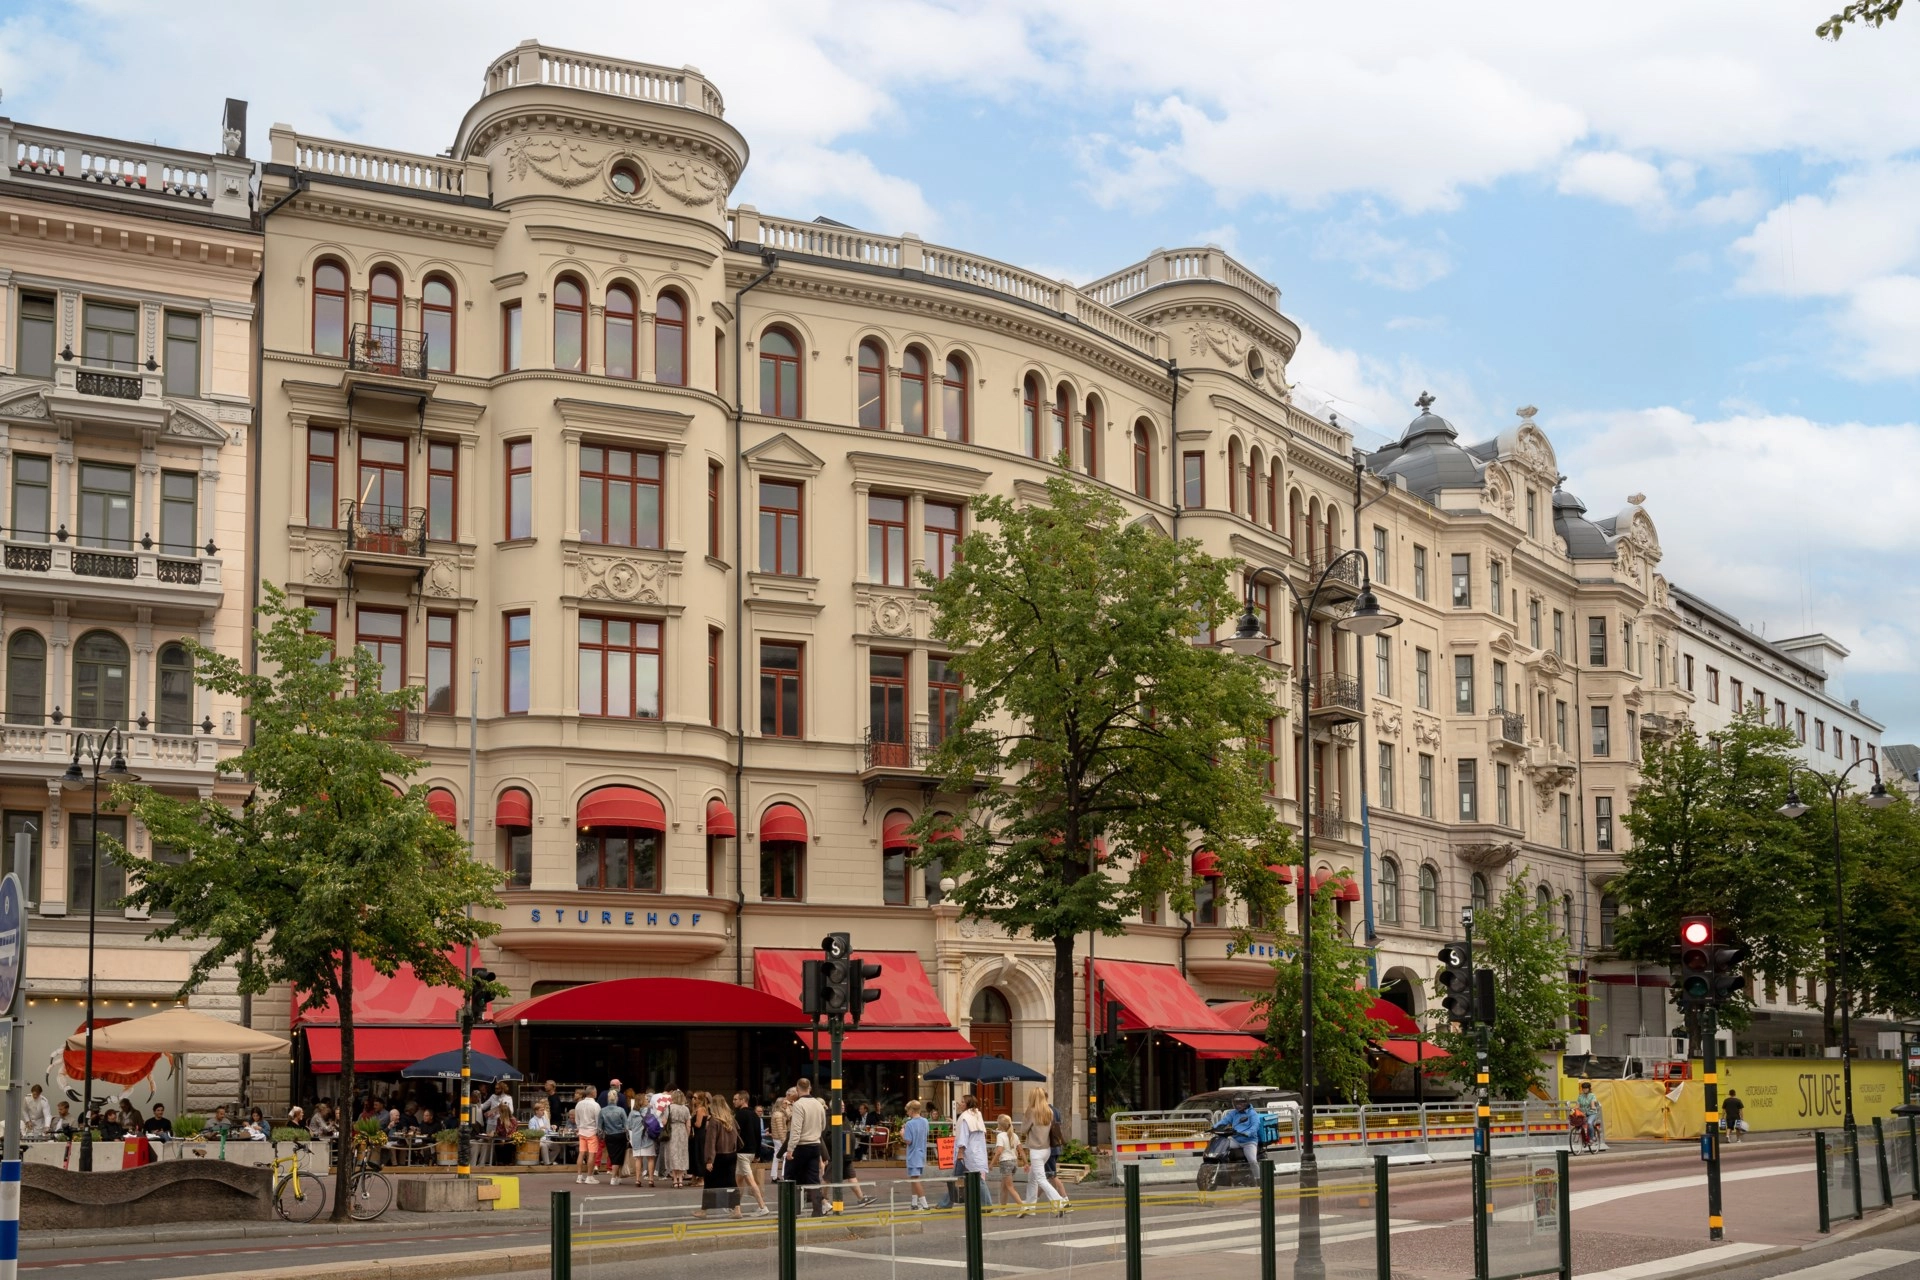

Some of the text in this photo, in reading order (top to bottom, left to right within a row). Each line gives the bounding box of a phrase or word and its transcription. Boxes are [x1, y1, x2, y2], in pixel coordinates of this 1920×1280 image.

[531, 908, 701, 927] STUREHOF
[831, 940, 840, 955] S
[1450, 950, 1460, 965] S
[1798, 1073, 1842, 1117] STURE
